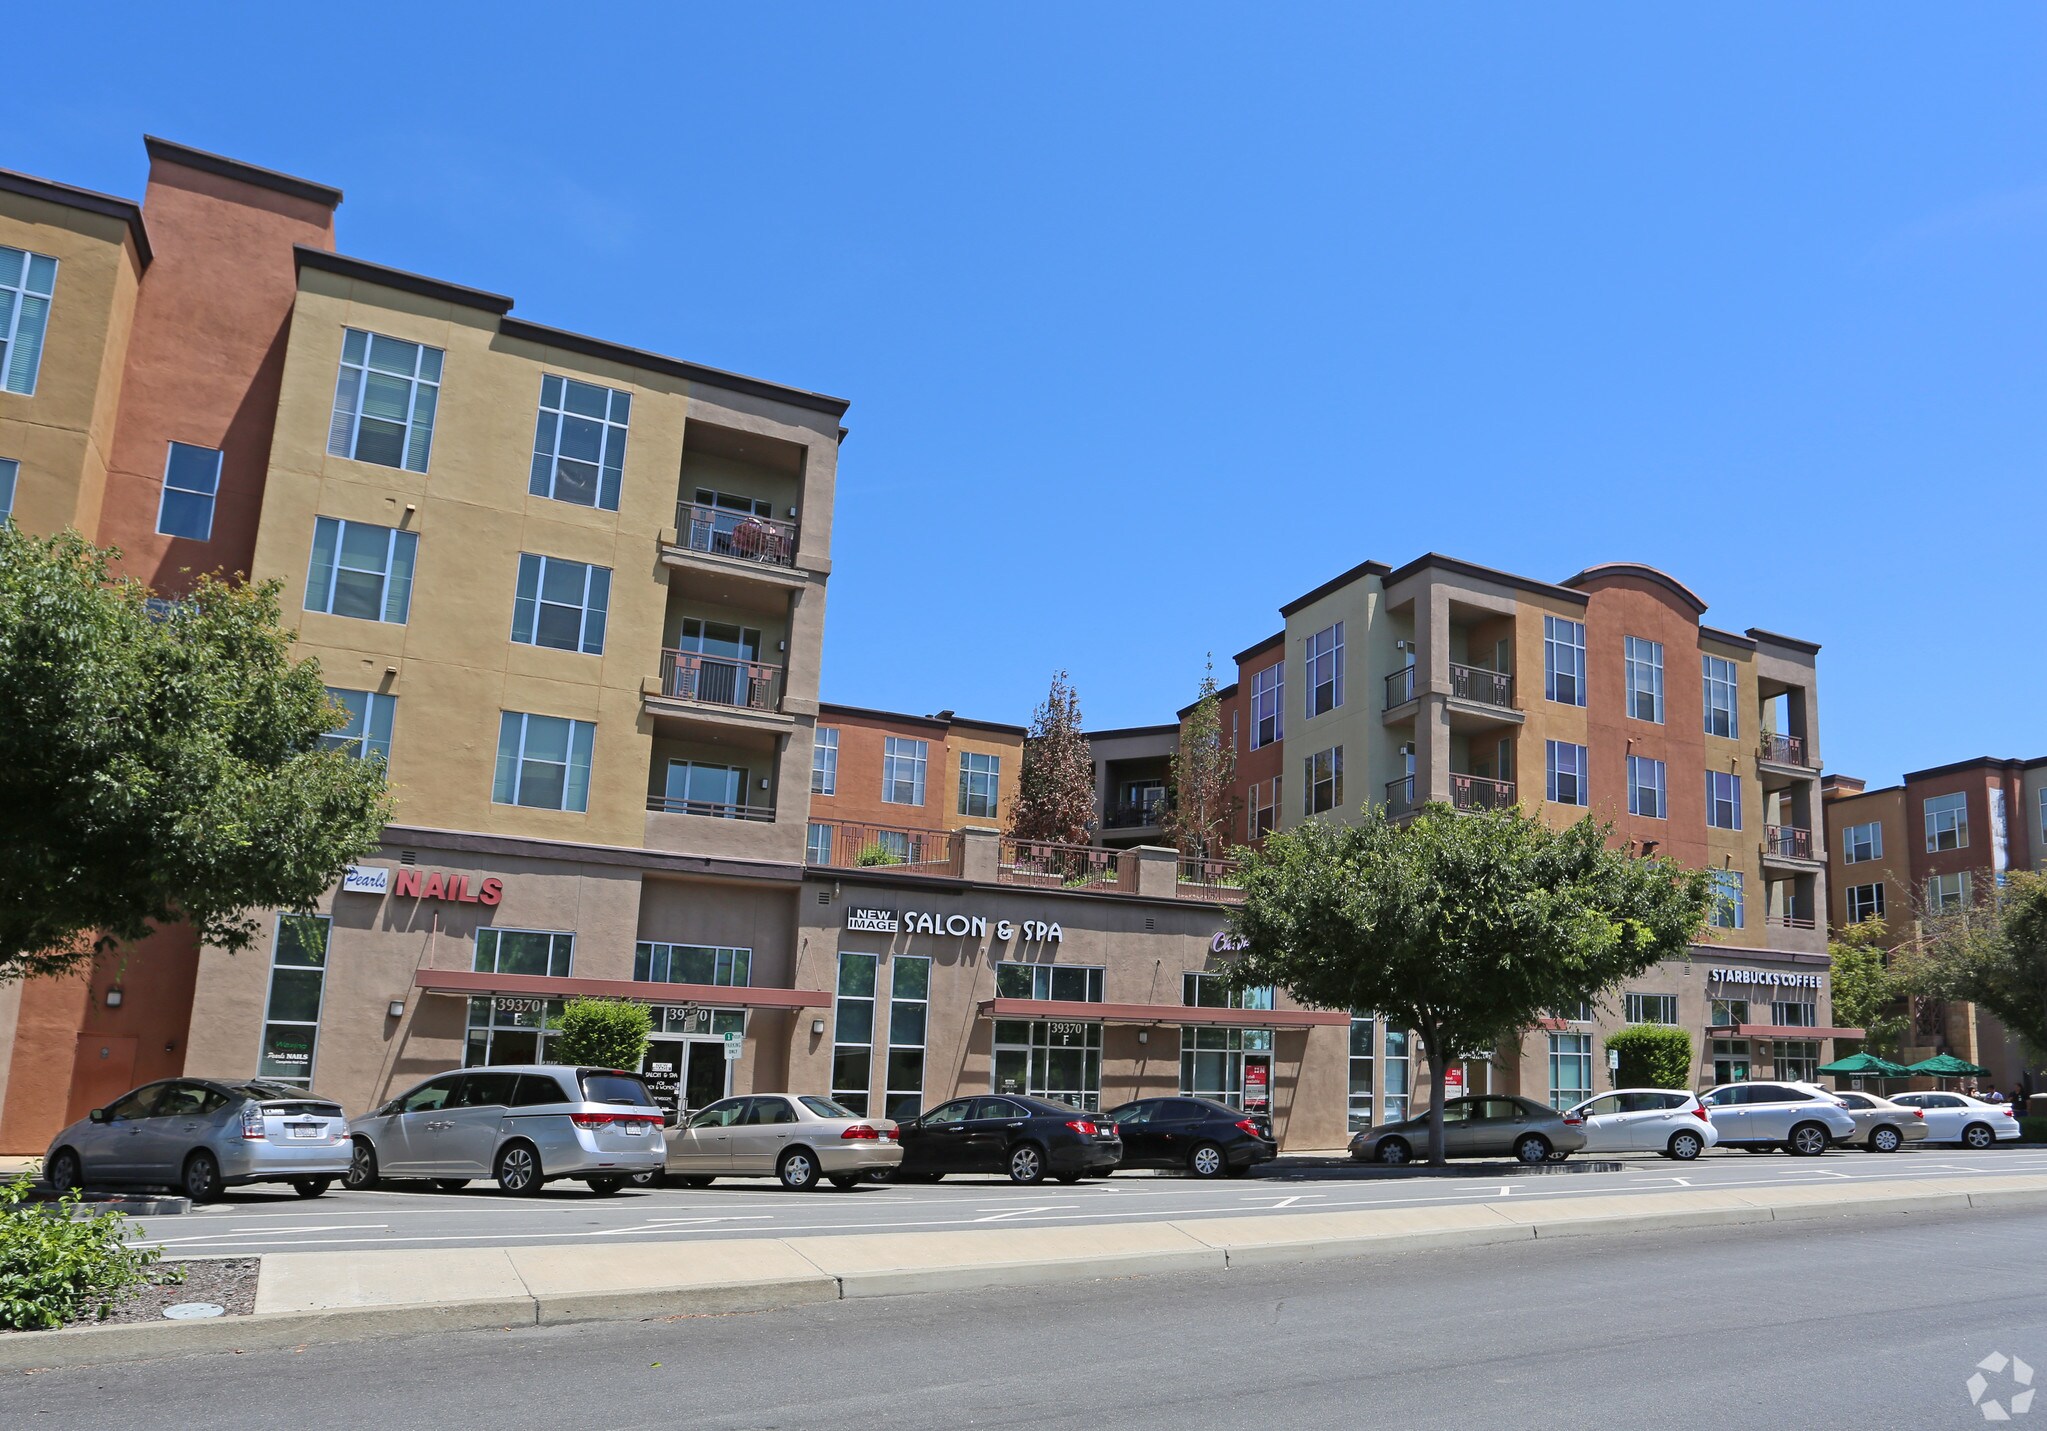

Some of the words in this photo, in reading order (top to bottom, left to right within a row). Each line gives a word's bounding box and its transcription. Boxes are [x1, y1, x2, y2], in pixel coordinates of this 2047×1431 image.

[345, 867, 387, 888] Pearls
[396, 868, 504, 906] NAILS
[856, 909, 891, 920] NEW
[849, 919, 897, 931] IMAGE
[904, 911, 987, 938] SALON
[997, 920, 1015, 941] &
[1023, 920, 1063, 943] SPA
[1712, 969, 1780, 985] STARBUCKS
[1781, 973, 1823, 988] COFFEE
[497, 998, 541, 1012] 39370
[513, 1012, 522, 1025] E
[1051, 1022, 1082, 1034] 39370
[1063, 1035, 1069, 1046] F
